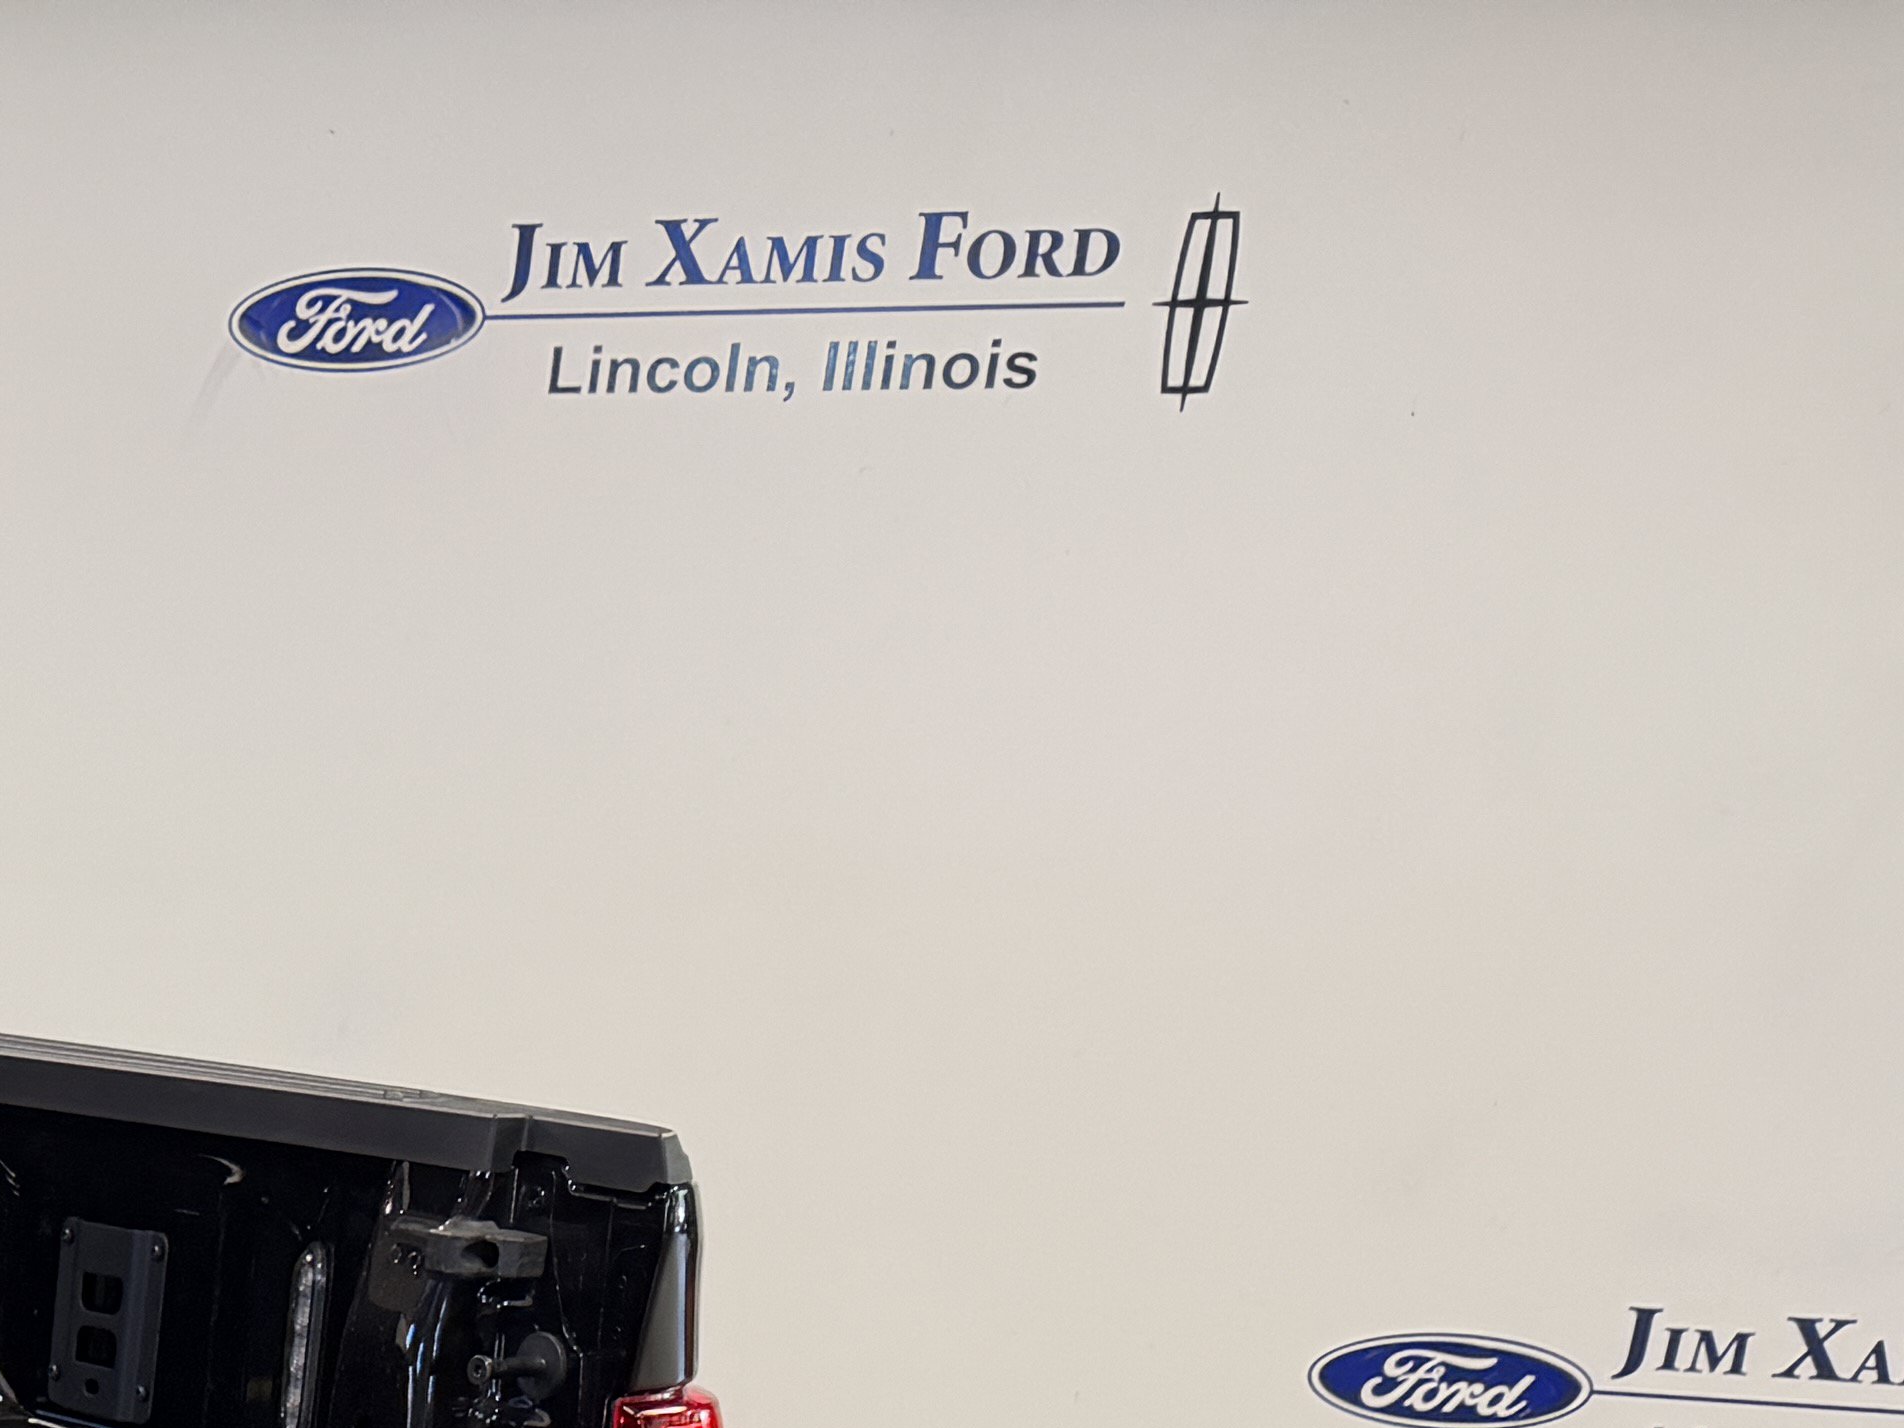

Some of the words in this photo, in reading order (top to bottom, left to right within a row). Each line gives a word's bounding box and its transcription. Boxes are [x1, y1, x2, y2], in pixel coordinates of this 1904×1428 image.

[276, 287, 436, 354] Ford
[547, 342, 795, 403] Lincoln,
[821, 338, 1039, 393] Illinois
[1360, 1349, 1536, 1418] Ford
